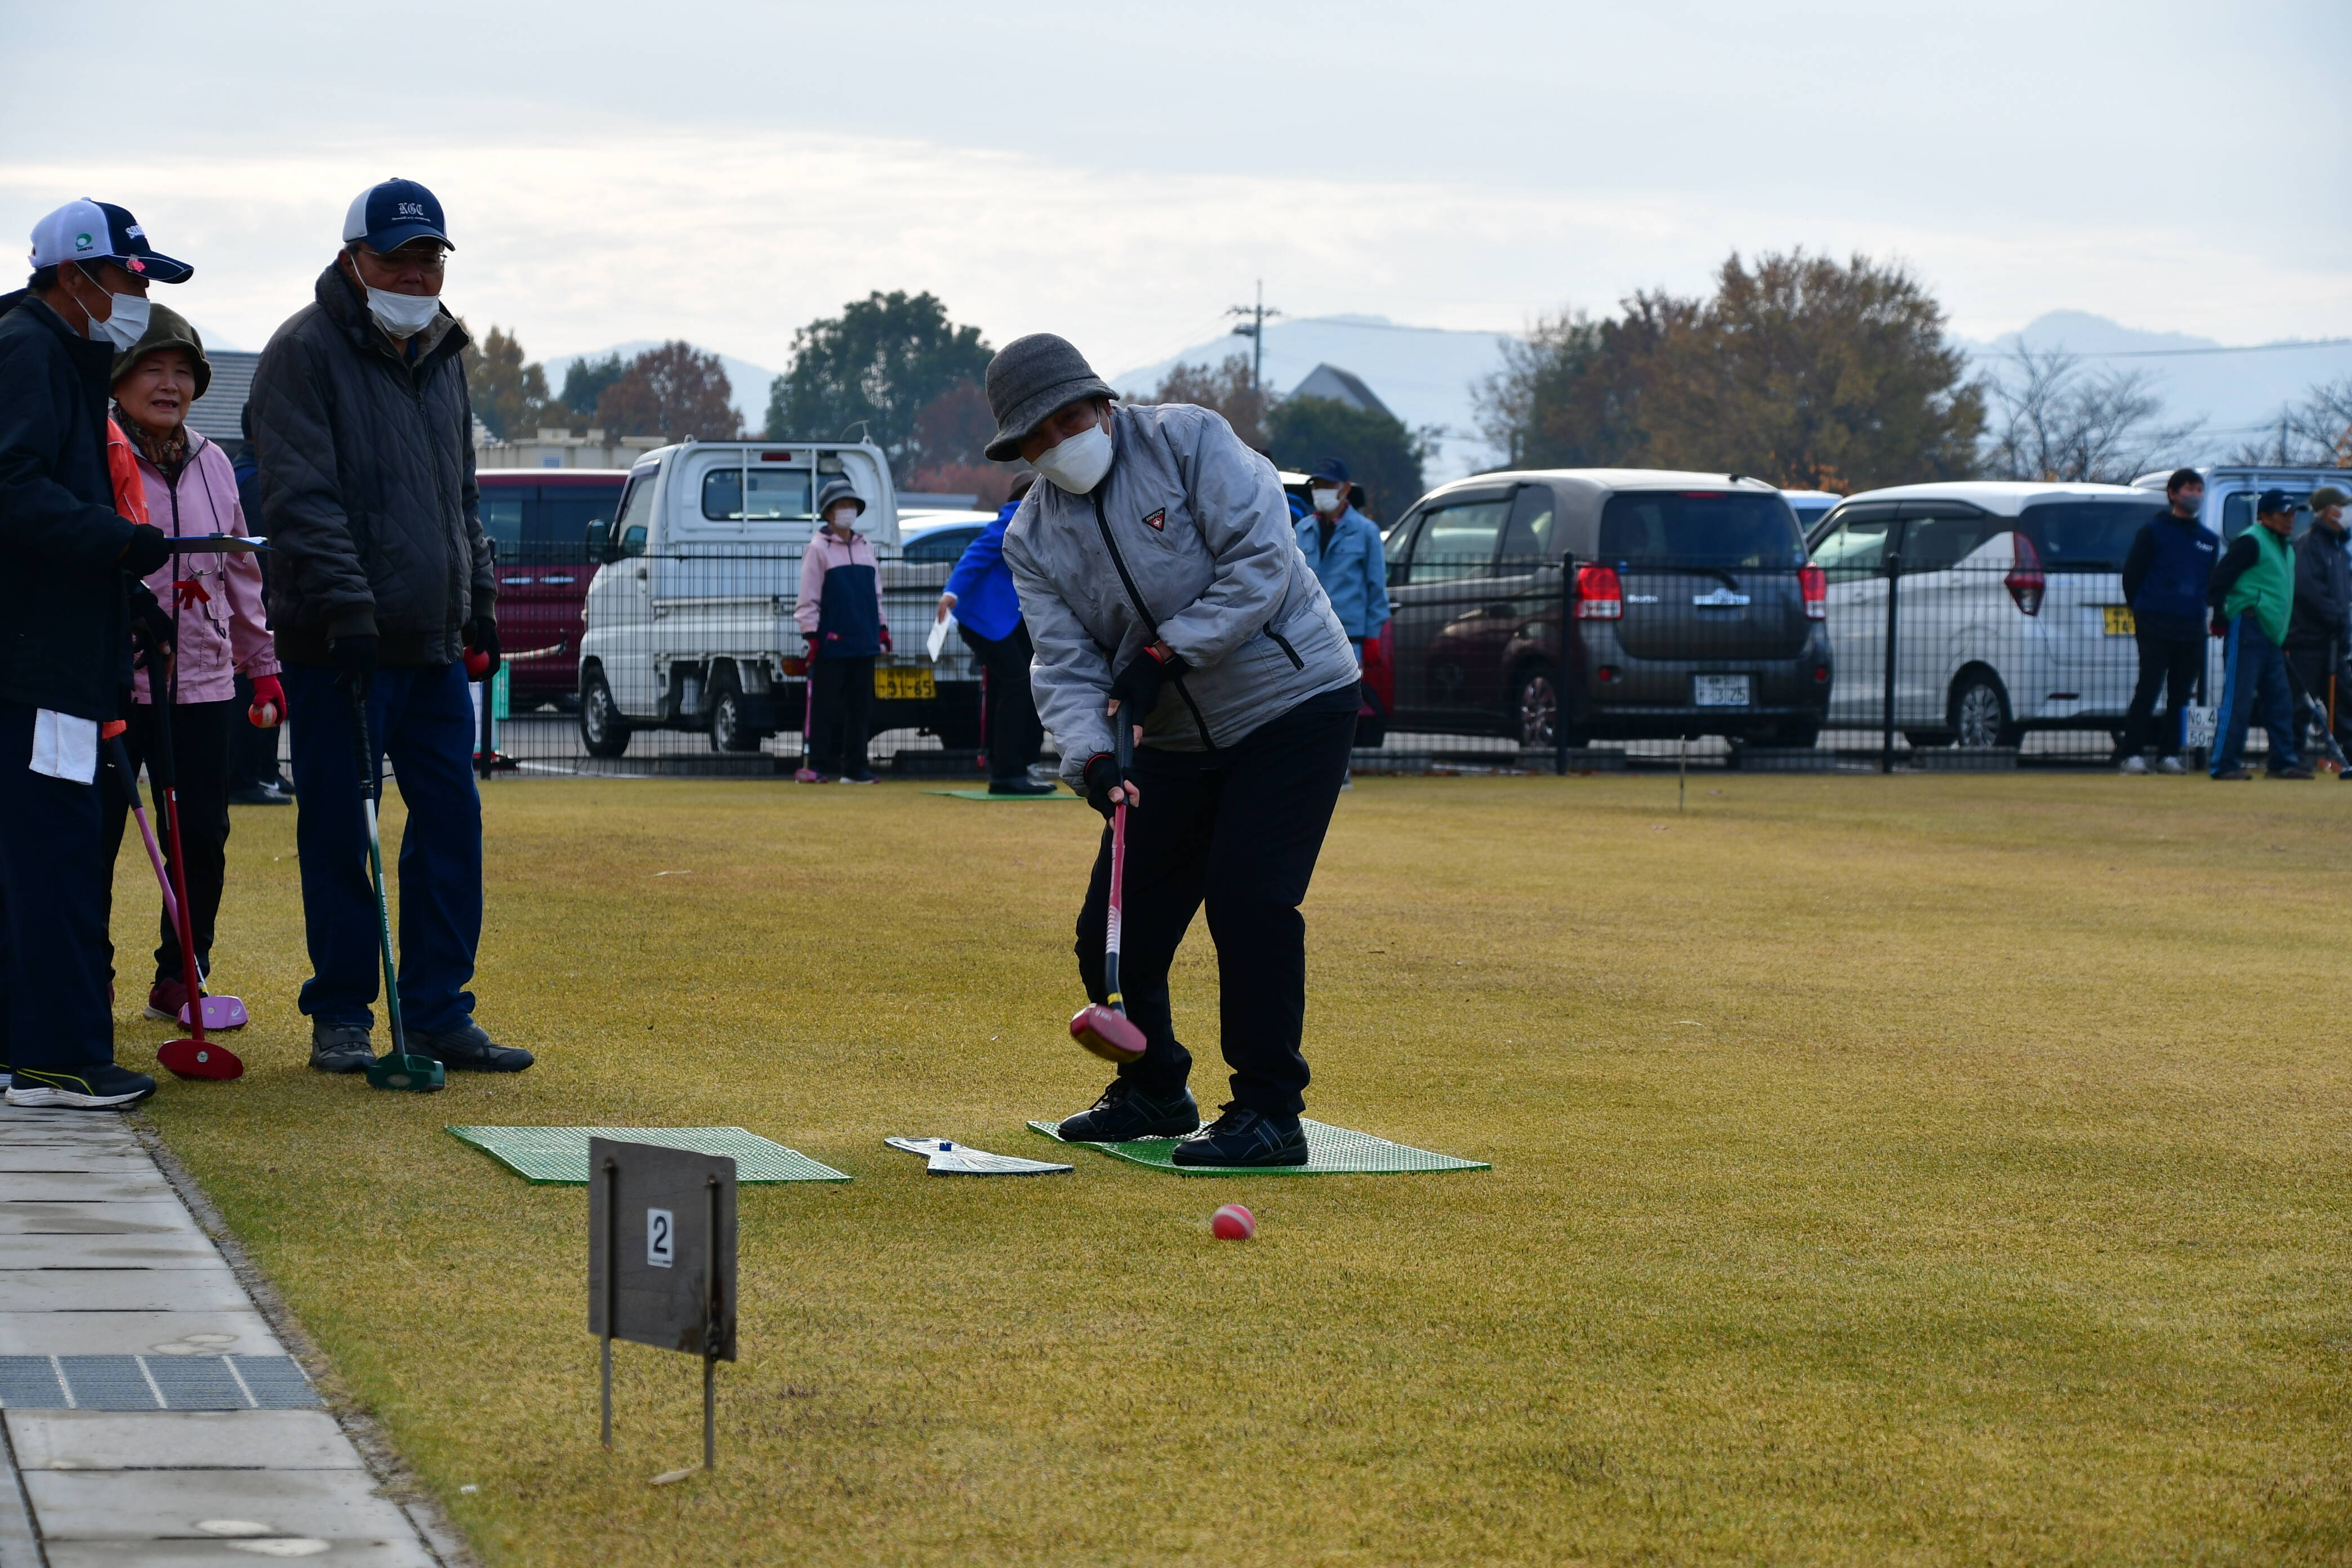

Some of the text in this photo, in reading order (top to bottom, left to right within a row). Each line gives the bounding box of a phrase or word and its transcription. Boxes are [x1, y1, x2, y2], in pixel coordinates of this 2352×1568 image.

[398, 202, 424, 215] KGC
[1146, 509, 1164, 522] SIMPSON
[653, 1216, 667, 1255] 2
